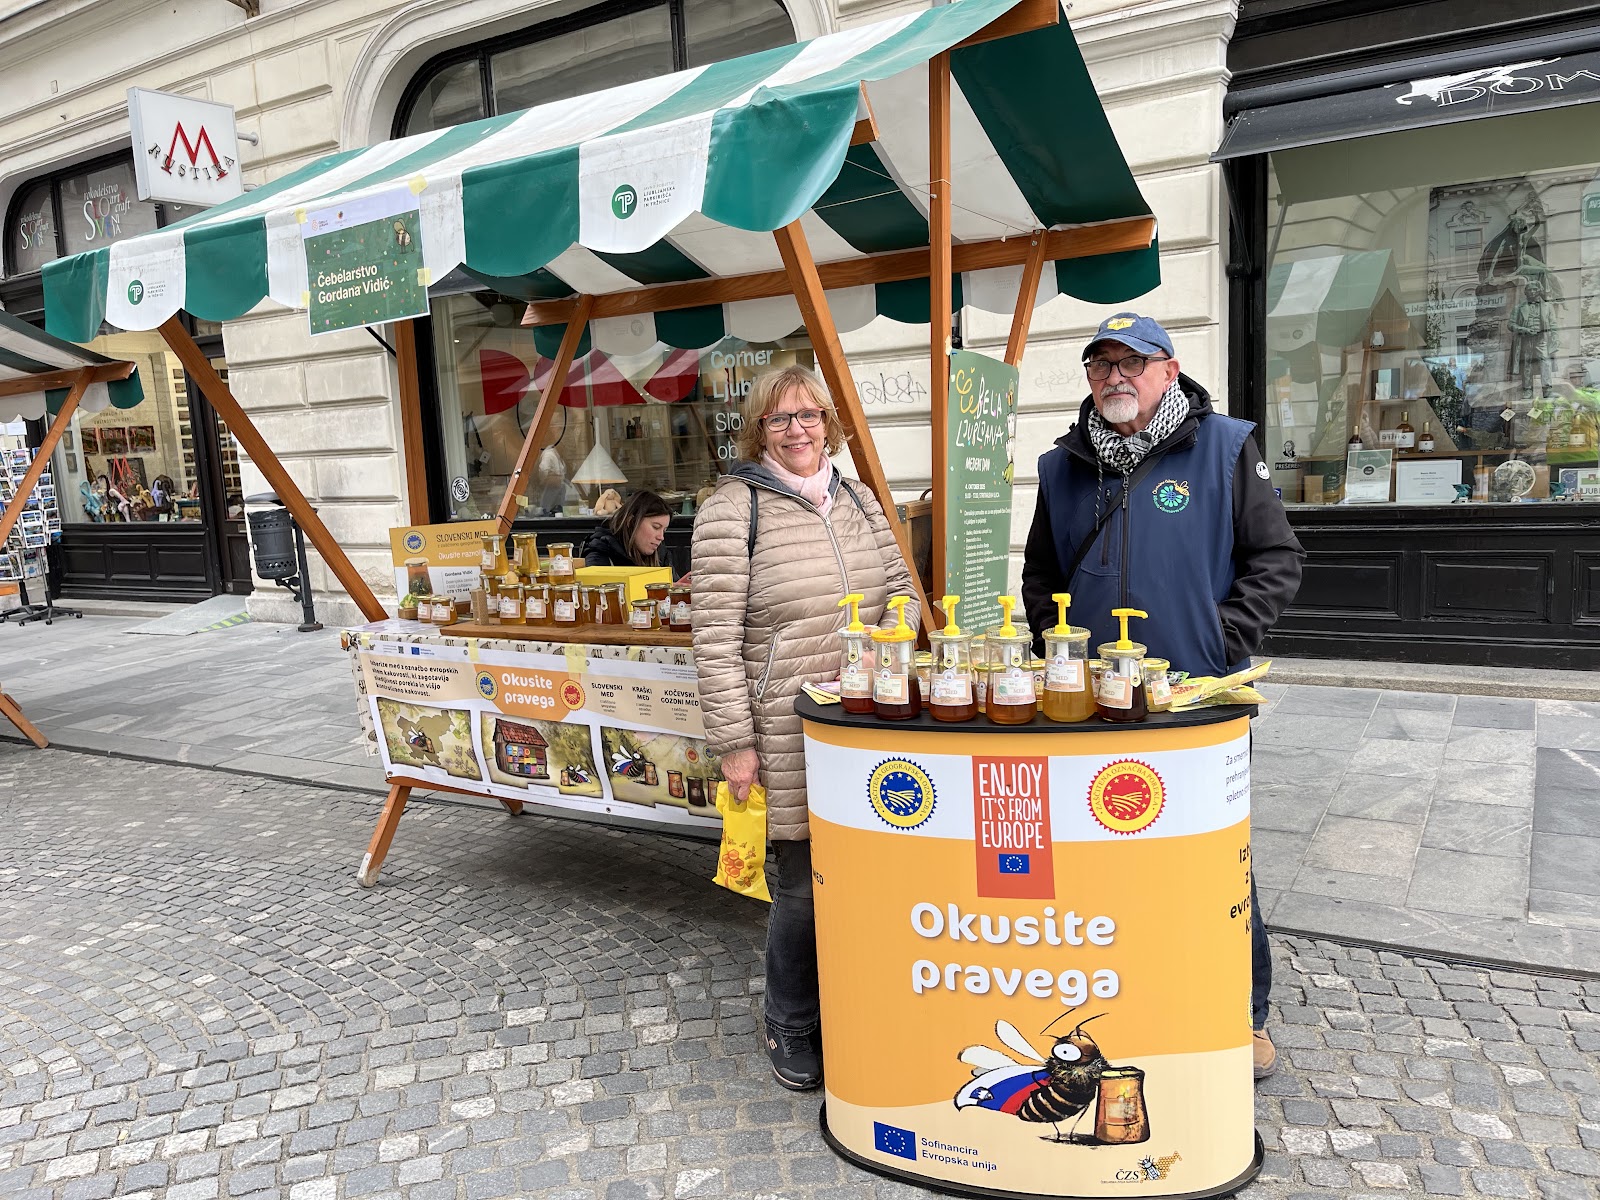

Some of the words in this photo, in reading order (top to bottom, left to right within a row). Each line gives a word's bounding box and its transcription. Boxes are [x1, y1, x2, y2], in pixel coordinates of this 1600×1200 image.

[148, 143, 235, 181] RUSTIKA
[84, 183, 118, 200] rokodelstvo
[644, 186, 676, 196] LJUBLJANSKA
[114, 196, 130, 215] craft
[318, 265, 378, 288] Čebelarstvo
[318, 286, 360, 304] Gordana
[362, 276, 390, 294] Vidić
[710, 350, 774, 368] Corner
[713, 376, 756, 402] Ljub
[718, 441, 738, 460] ob
[436, 532, 472, 542] SLOVENSKI
[429, 666, 459, 674] evropskih
[502, 673, 553, 689] Okusite
[591, 683, 623, 691] SLOVENSKI
[632, 686, 652, 694] KRAŠKI
[664, 689, 695, 698] KOČEVSKI
[504, 692, 555, 709] pravega
[660, 697, 684, 705] GOZDNI
[685, 698, 699, 706] MED
[881, 764, 923, 782] GEOGRAFSKA
[979, 763, 1043, 797] ENJOY
[1111, 765, 1146, 776] OZNAČBA
[1147, 774, 1160, 806] POREKLA
[982, 798, 1005, 820] IT'S
[1009, 798, 1042, 820] FROM
[982, 821, 1044, 849] EUROPE
[910, 902, 1116, 946] Okusite
[912, 959, 1120, 1007] pravega
[921, 1138, 978, 1155] Sofinancira
[922, 1150, 968, 1166] Evropska
[971, 1161, 997, 1172] unija
[1116, 1169, 1140, 1180] ČZS
